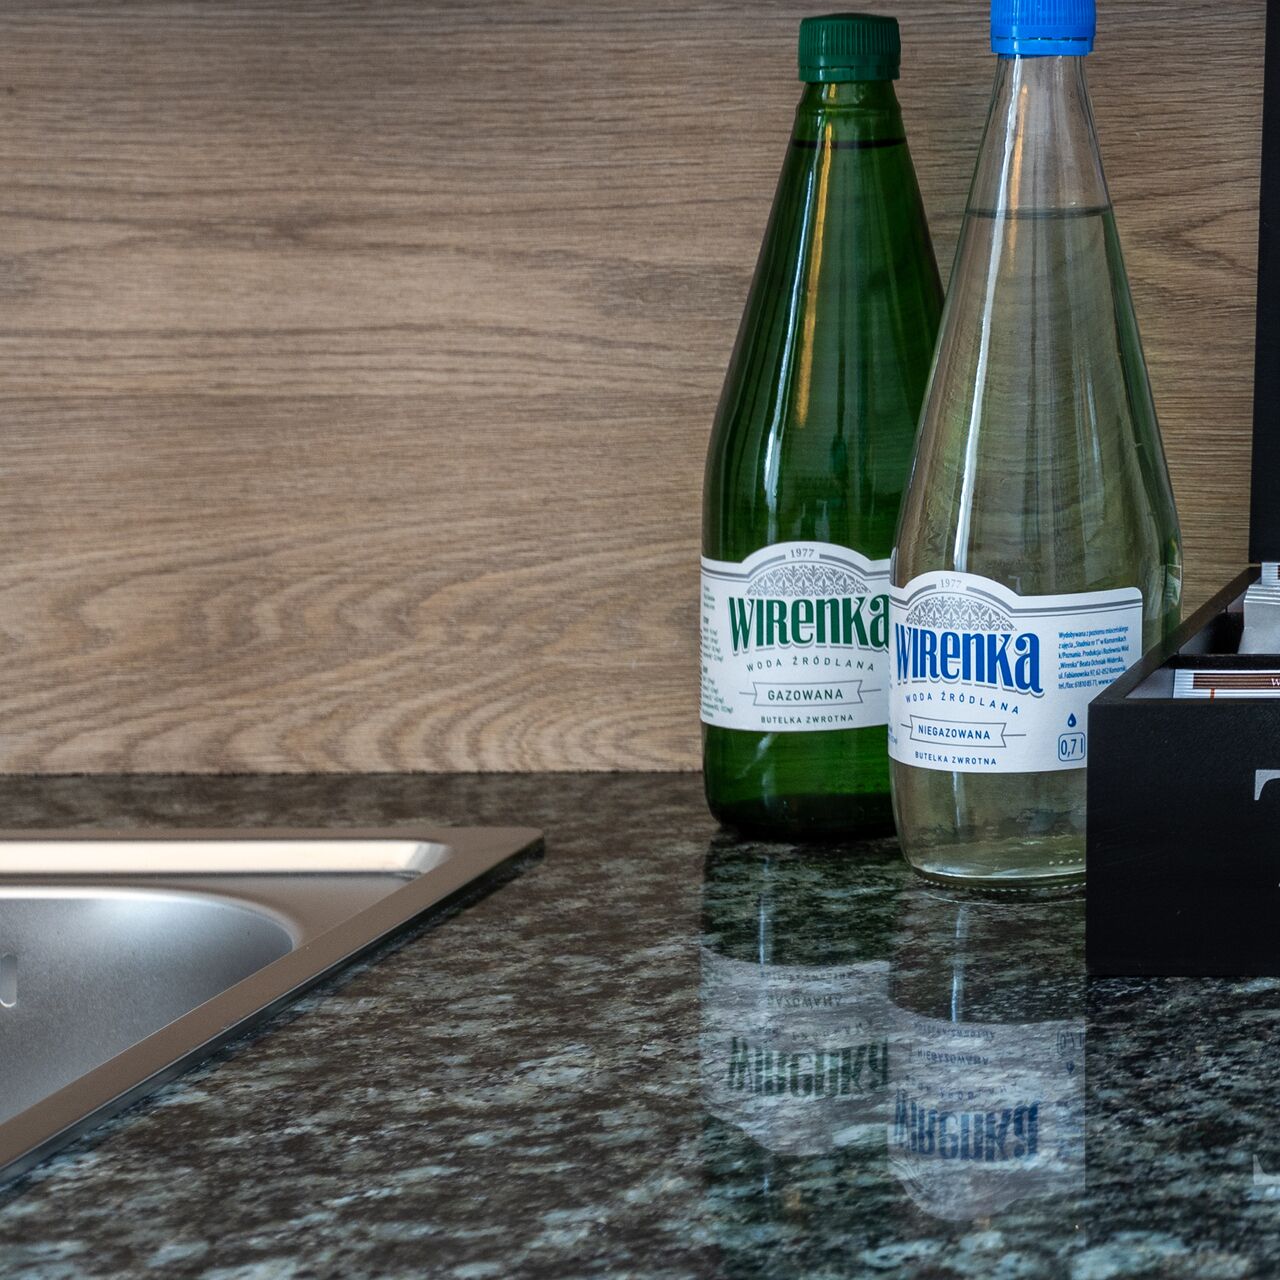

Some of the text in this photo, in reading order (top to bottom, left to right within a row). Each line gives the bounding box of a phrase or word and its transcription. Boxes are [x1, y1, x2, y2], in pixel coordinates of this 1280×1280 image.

[790, 548, 816, 558] 1977
[940, 578, 962, 589] 1977
[746, 658, 782, 672] WODA
[767, 688, 844, 701] GAZOWANA
[905, 692, 933, 703] WODA
[760, 713, 854, 724] BUTELKA ZWROTNA
[918, 724, 991, 740] NIEGAZOWANA
[1060, 738, 1077, 758] 0,7
[914, 750, 997, 765] BUTELKA ZWROTNA
